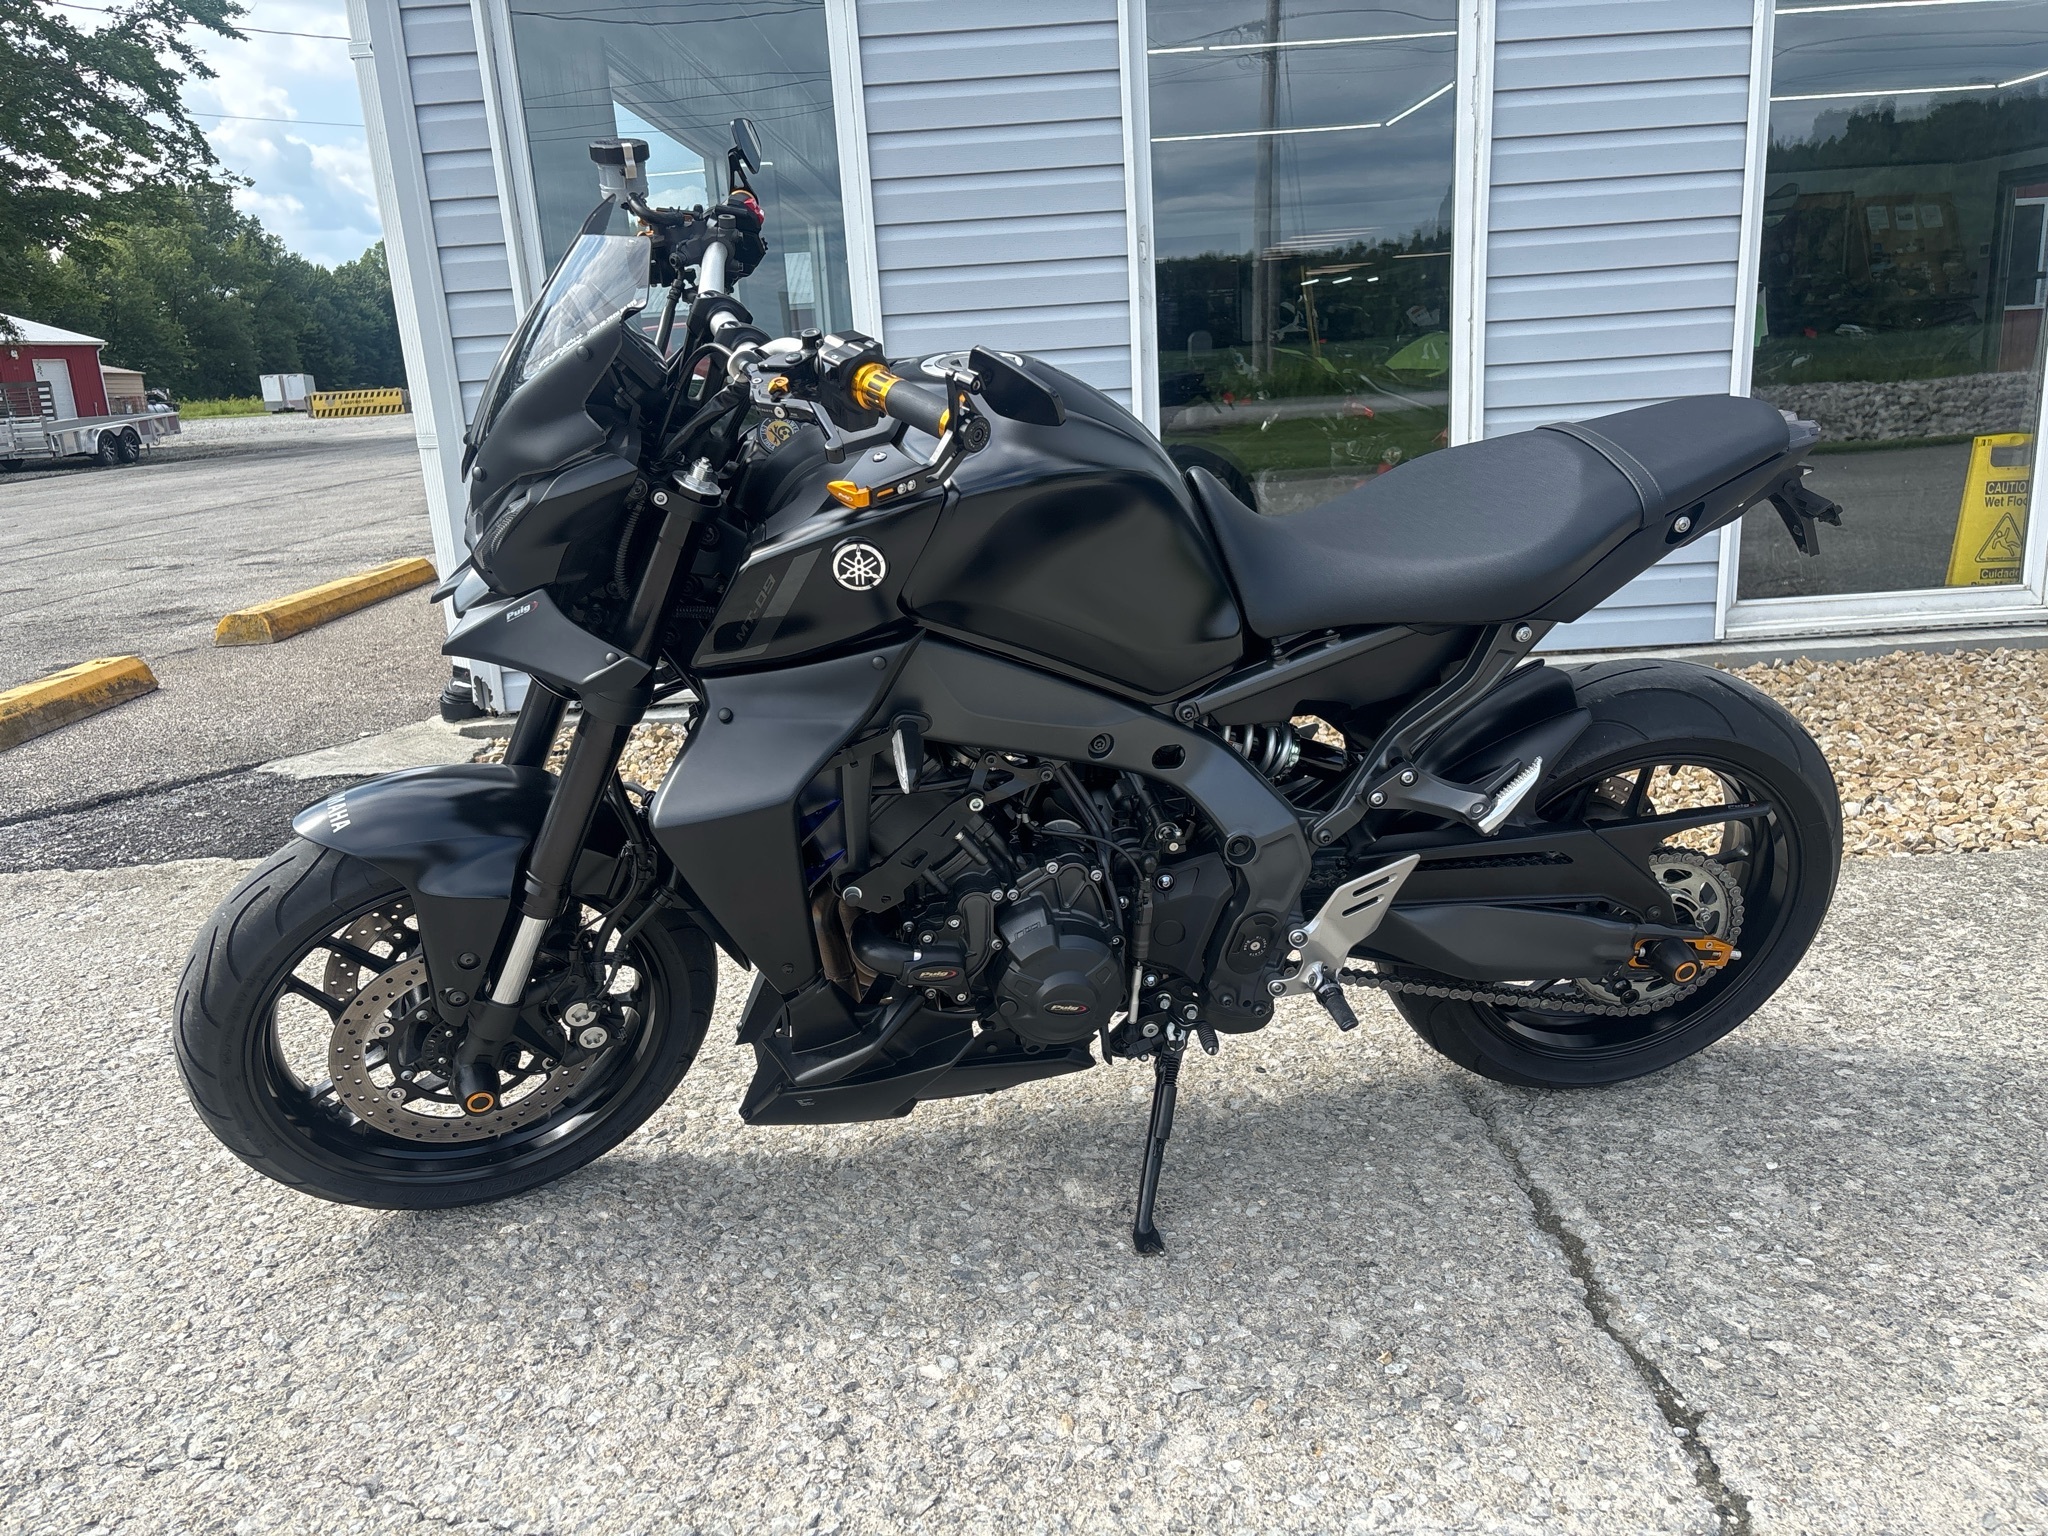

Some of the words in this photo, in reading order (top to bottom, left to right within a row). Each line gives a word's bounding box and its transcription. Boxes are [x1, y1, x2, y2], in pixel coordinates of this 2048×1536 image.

[1987, 481, 2027, 494] CAUTIO
[1985, 496, 2004, 507] Wet
[2007, 495, 2028, 506] Floo
[506, 604, 531, 621] Puig
[736, 573, 776, 642] MT-09
[327, 792, 351, 833] MAHA
